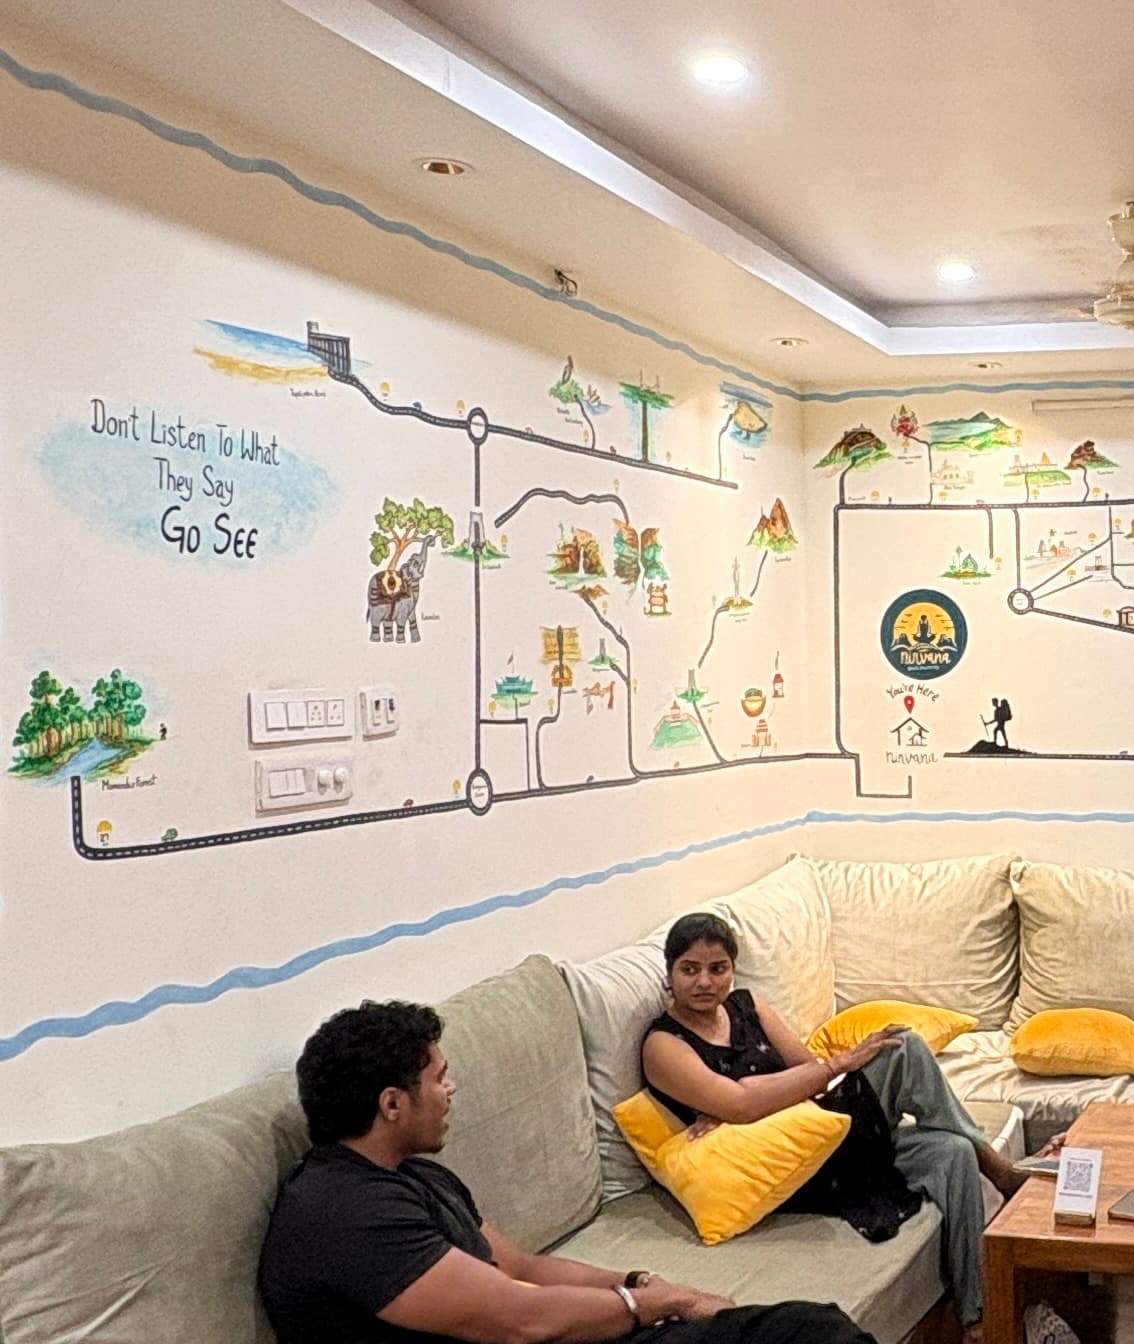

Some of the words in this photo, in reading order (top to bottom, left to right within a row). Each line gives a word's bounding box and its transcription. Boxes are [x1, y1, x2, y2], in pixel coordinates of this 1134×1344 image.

[90, 398, 140, 442] Don't
[150, 409, 207, 454] Listen
[216, 423, 234, 457] To
[240, 428, 281, 466] What
[152, 456, 194, 502] They
[202, 464, 234, 507] Say
[916, 683, 940, 703] Here
